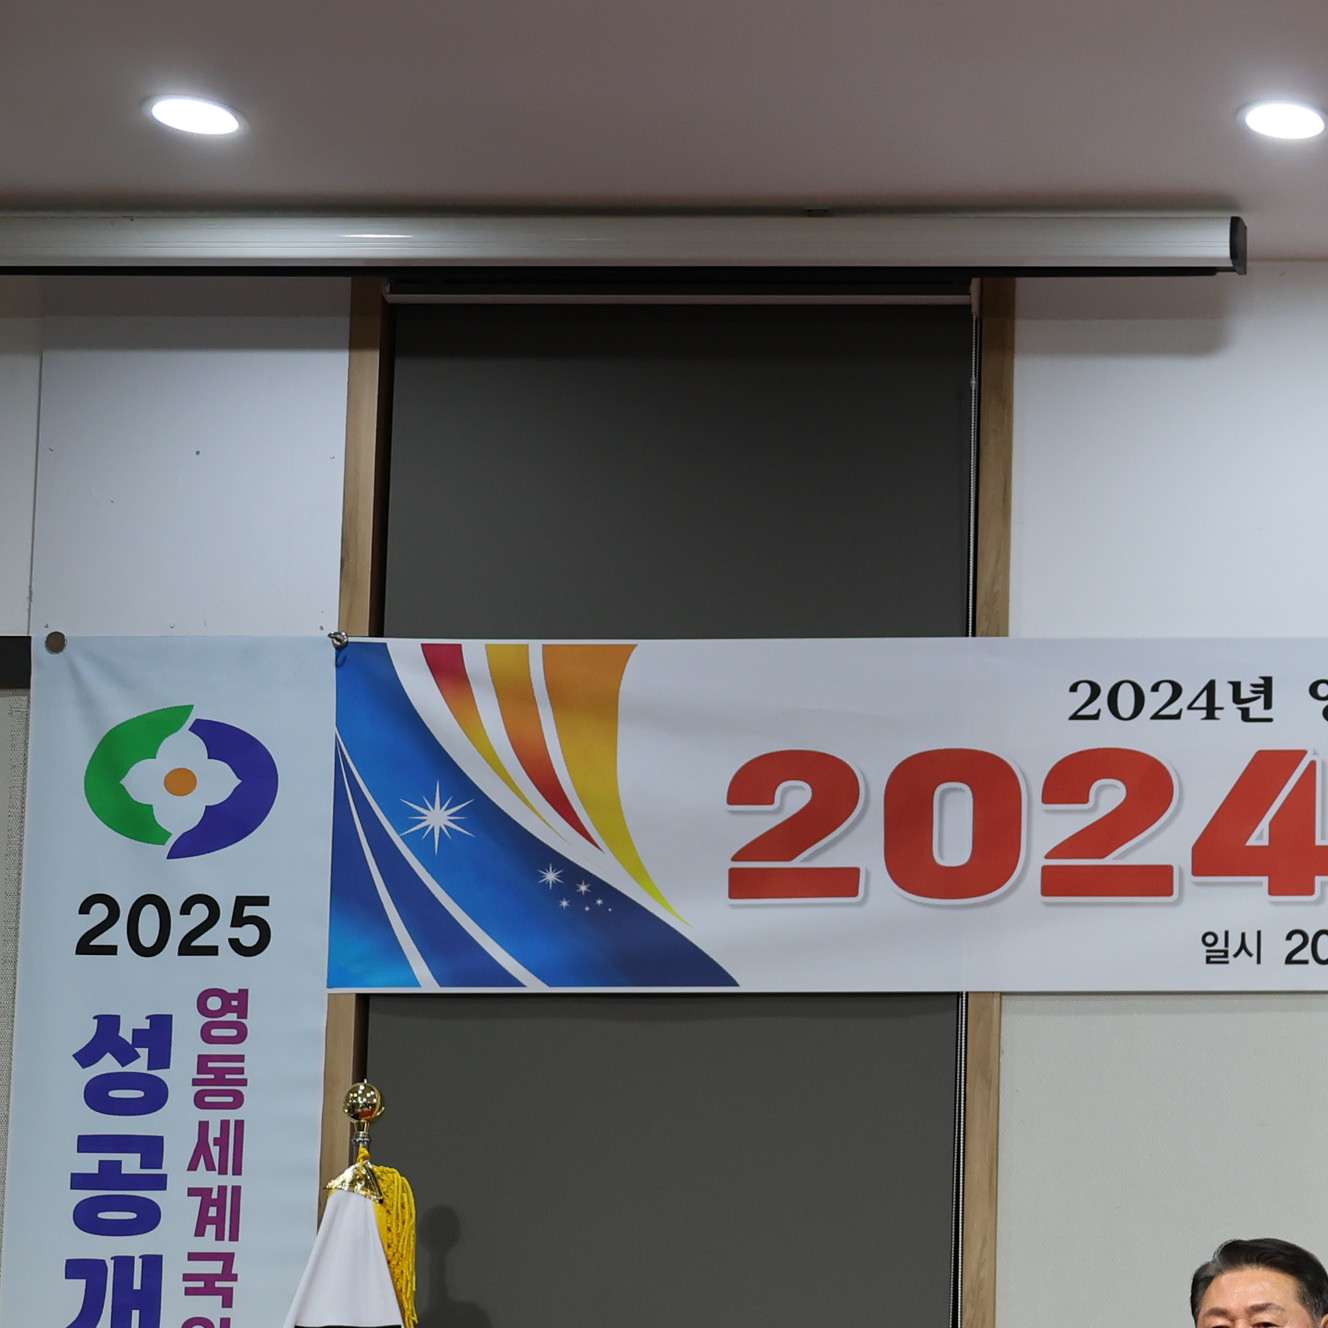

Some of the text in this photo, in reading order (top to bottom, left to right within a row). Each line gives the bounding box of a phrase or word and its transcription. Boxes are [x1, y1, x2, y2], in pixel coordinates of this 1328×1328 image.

[1068, 676, 1274, 723] 2024년
[74, 893, 272, 958] 2025
[1201, 930, 1262, 965] 일시
